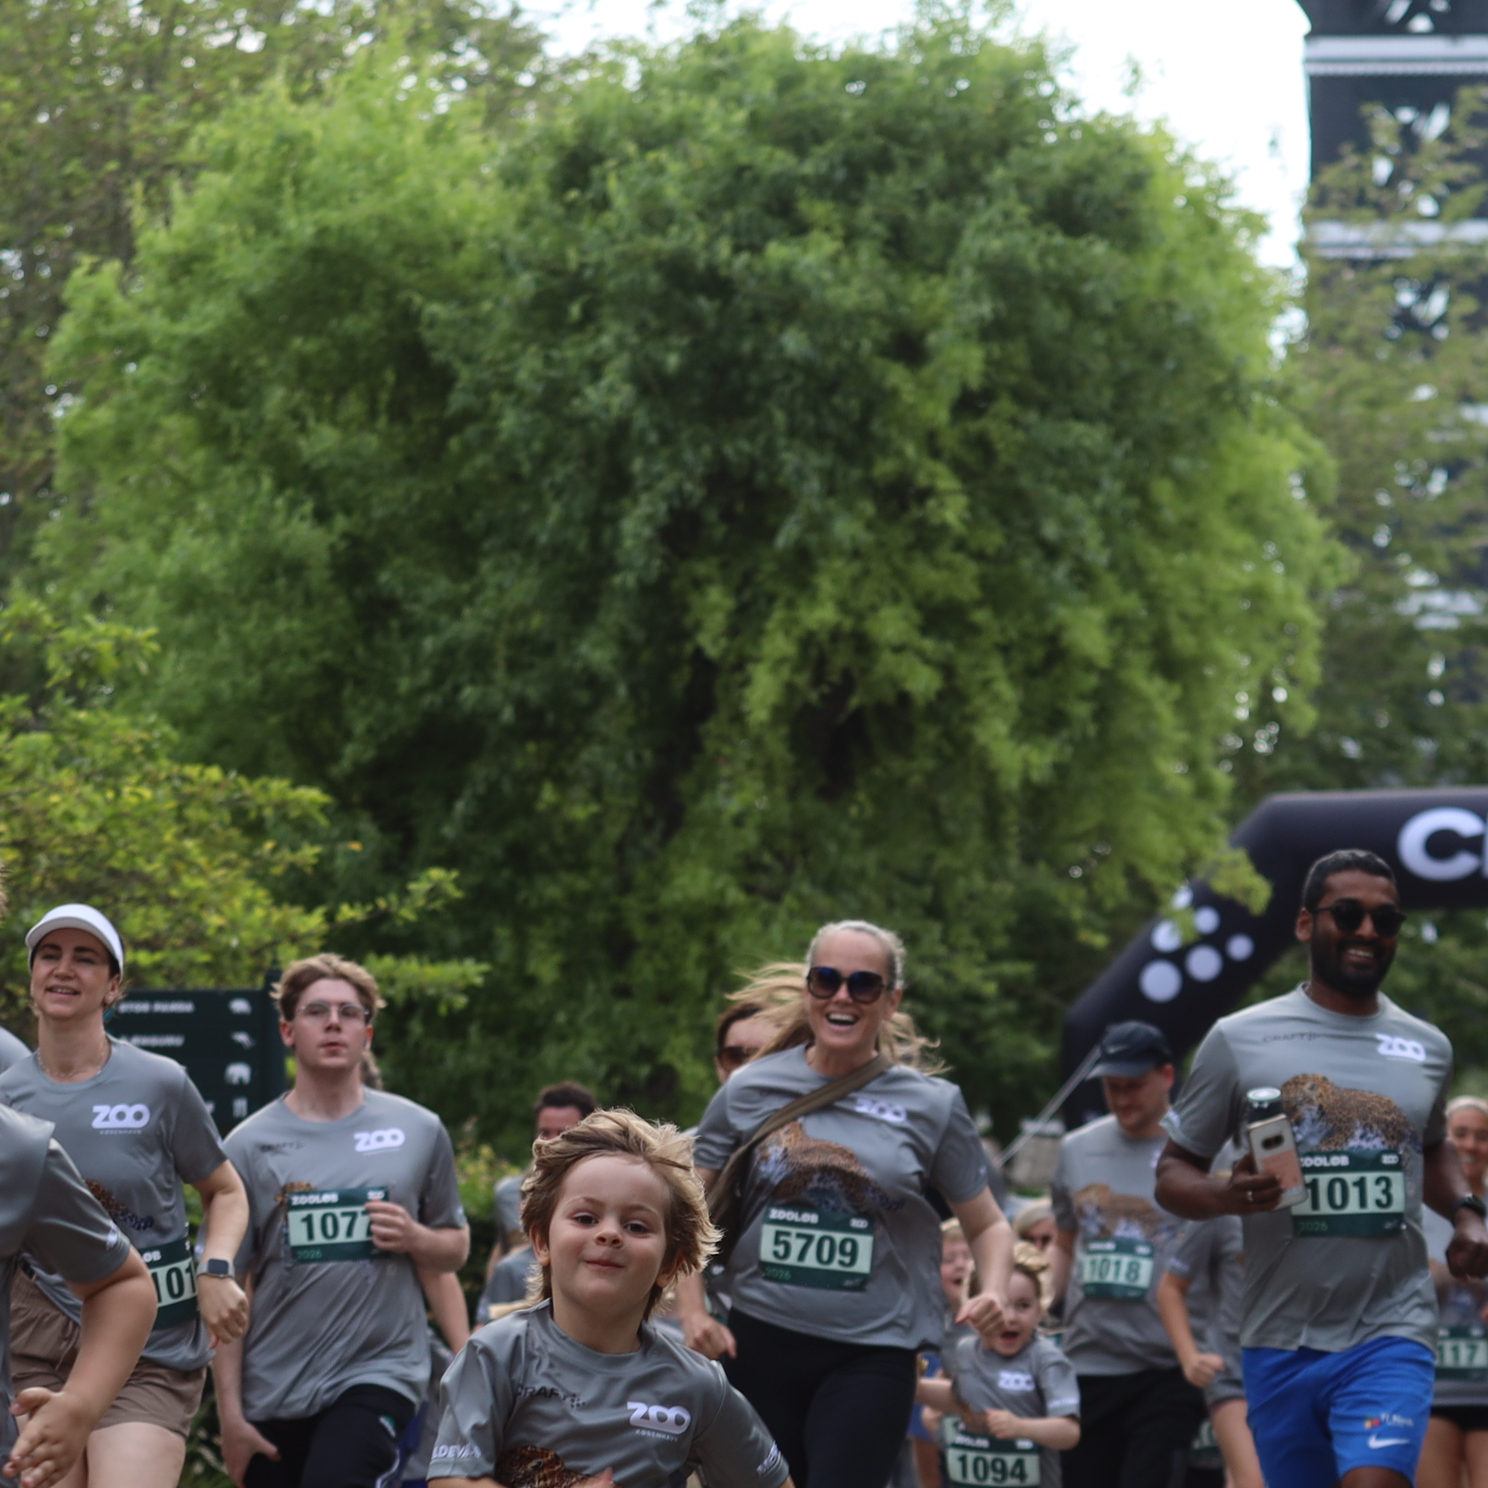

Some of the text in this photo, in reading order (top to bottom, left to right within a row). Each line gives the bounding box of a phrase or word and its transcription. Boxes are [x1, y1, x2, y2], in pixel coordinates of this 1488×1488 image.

[1375, 1034, 1426, 1061] ZOO
[92, 1104, 150, 1128] ZOO
[354, 1129, 405, 1151] ZOO
[1306, 1175, 1393, 1211] 1013
[772, 1230, 859, 1268] 5709
[152, 1261, 196, 1303] 101
[1090, 1258, 1141, 1284] 1018
[627, 1401, 691, 1435] ZOO
[958, 1455, 1028, 1483] 1094
